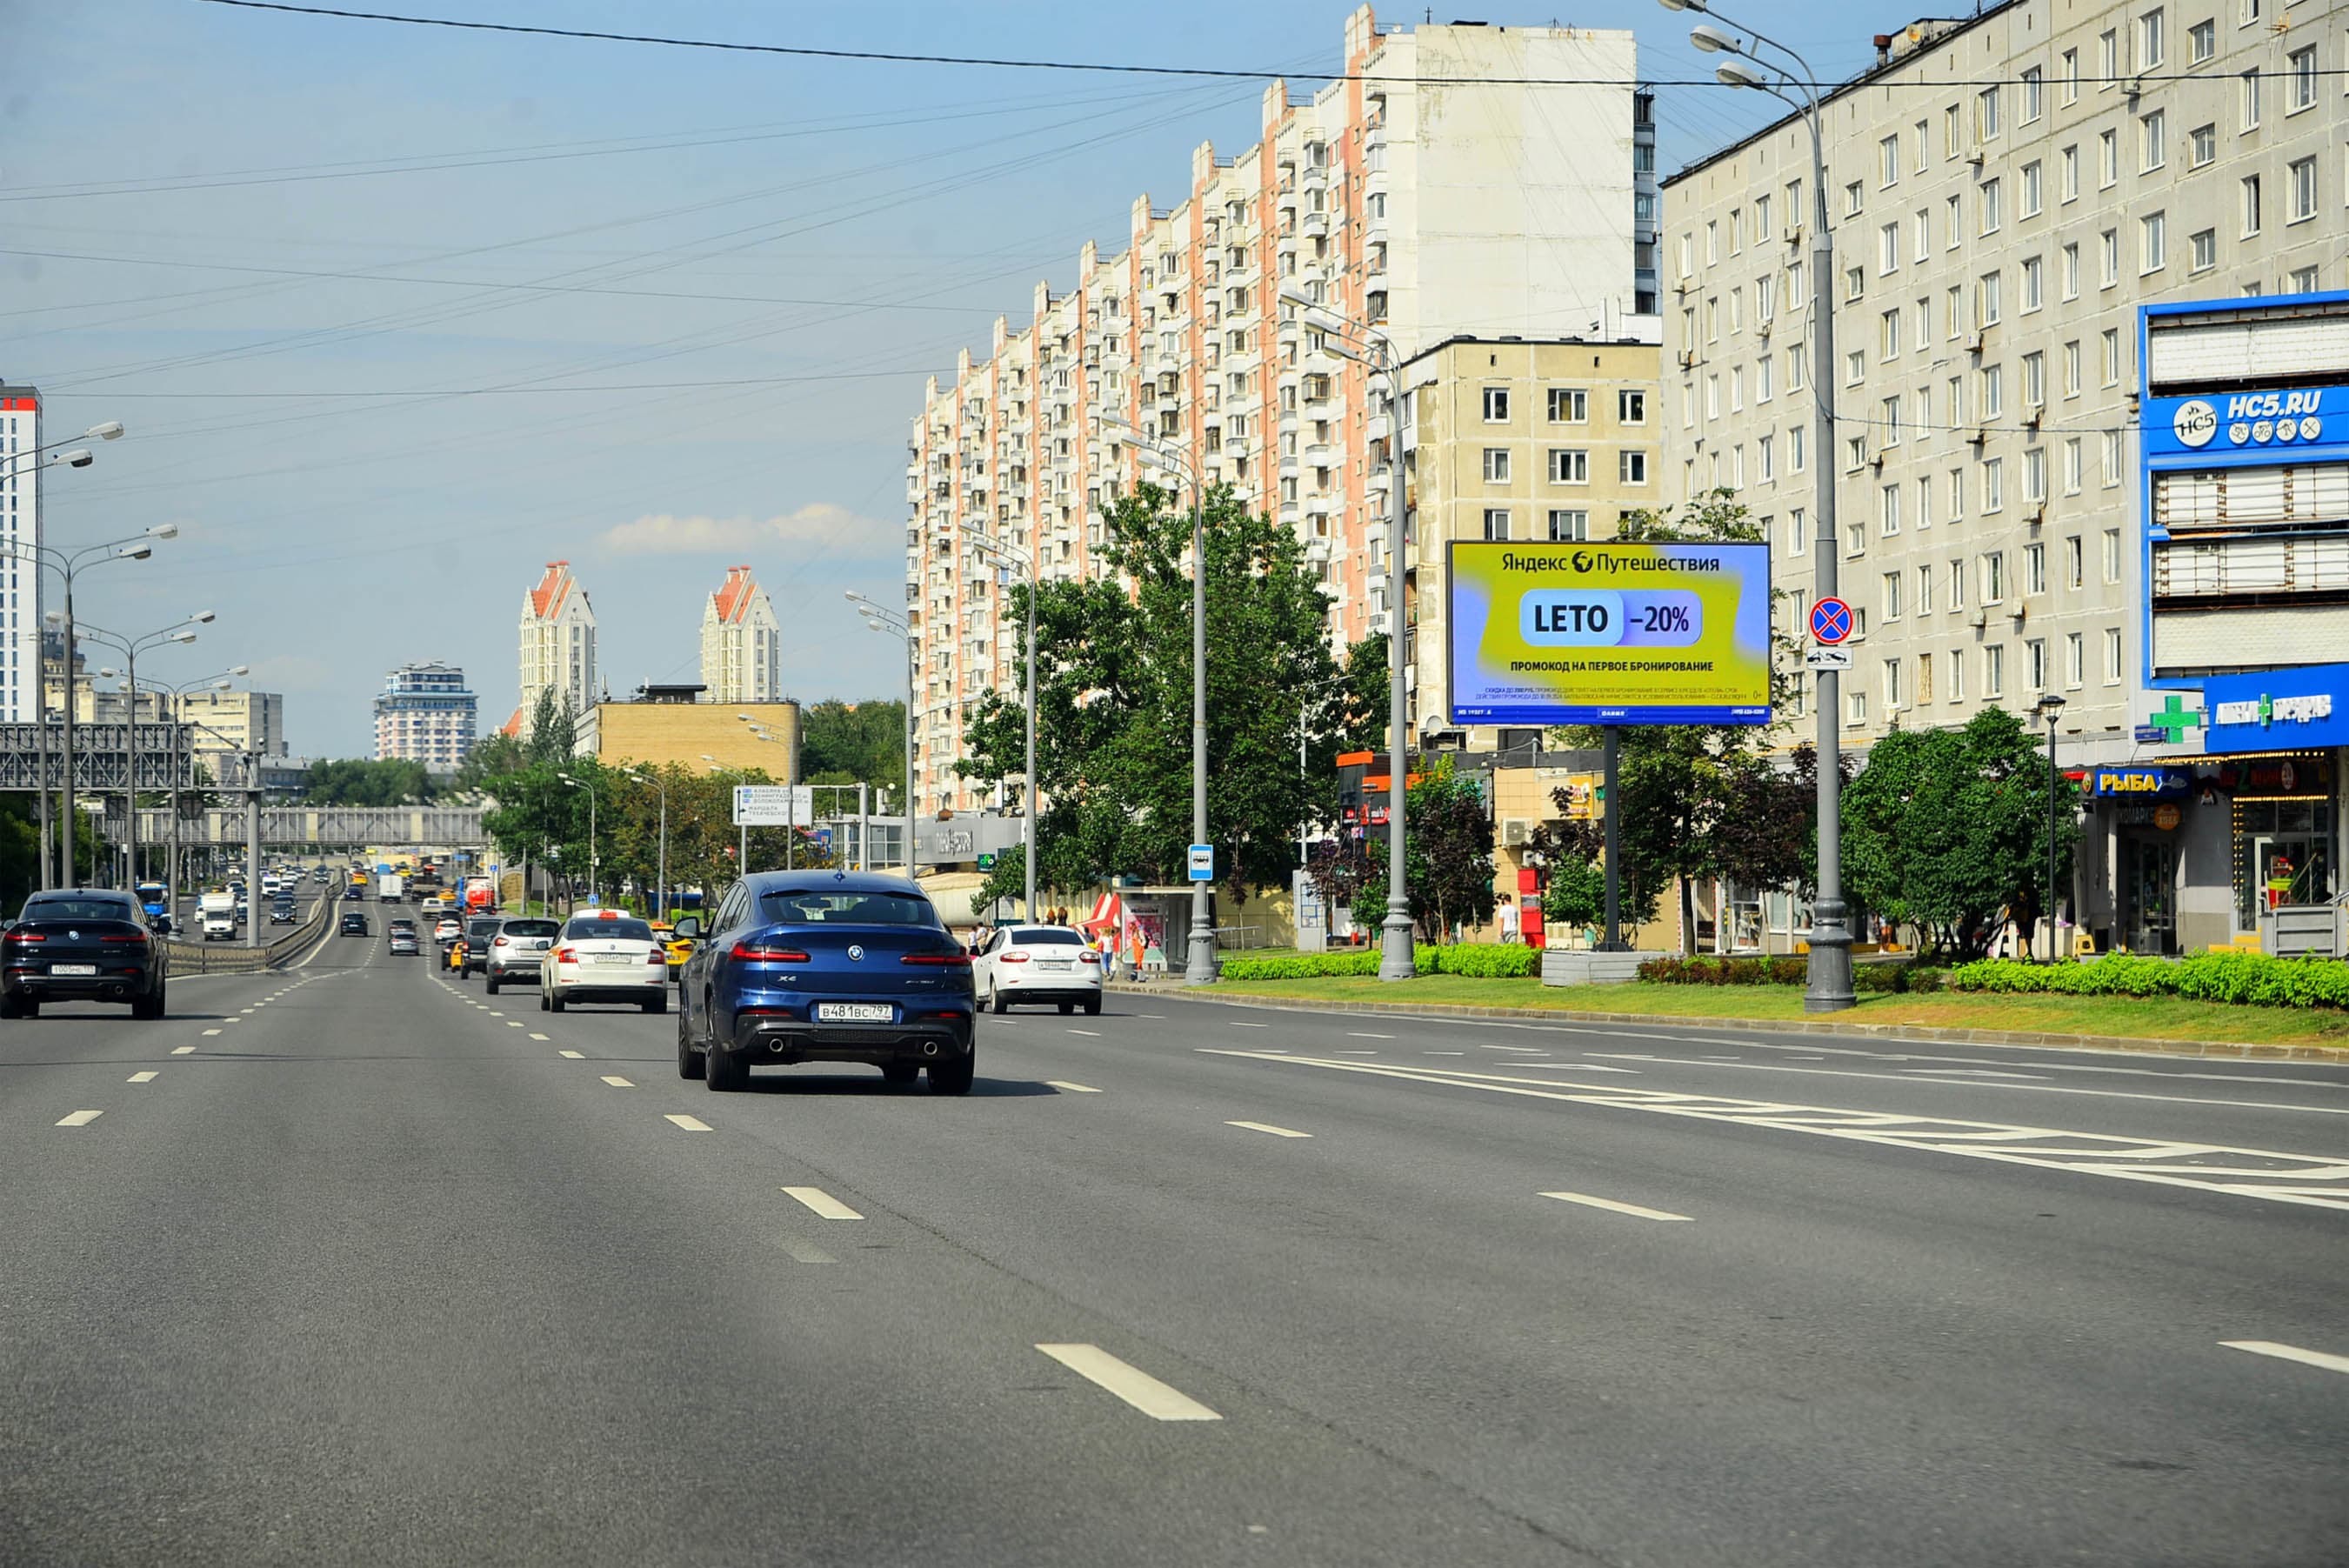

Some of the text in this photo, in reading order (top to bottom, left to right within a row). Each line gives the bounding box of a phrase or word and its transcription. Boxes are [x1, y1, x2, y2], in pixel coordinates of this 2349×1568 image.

[2227, 390, 2321, 419] HC5.RU
[1502, 552, 1719, 574] Яндекс Путешествия
[1535, 604, 1608, 632] LETO
[1510, 661, 1714, 673] ПРОМОКОД НА ПЕРВОЕ БРОНИРОВАНИЕ
[2099, 773, 2158, 792] РЫБА
[823, 1005, 890, 1018] В481ВС 797
